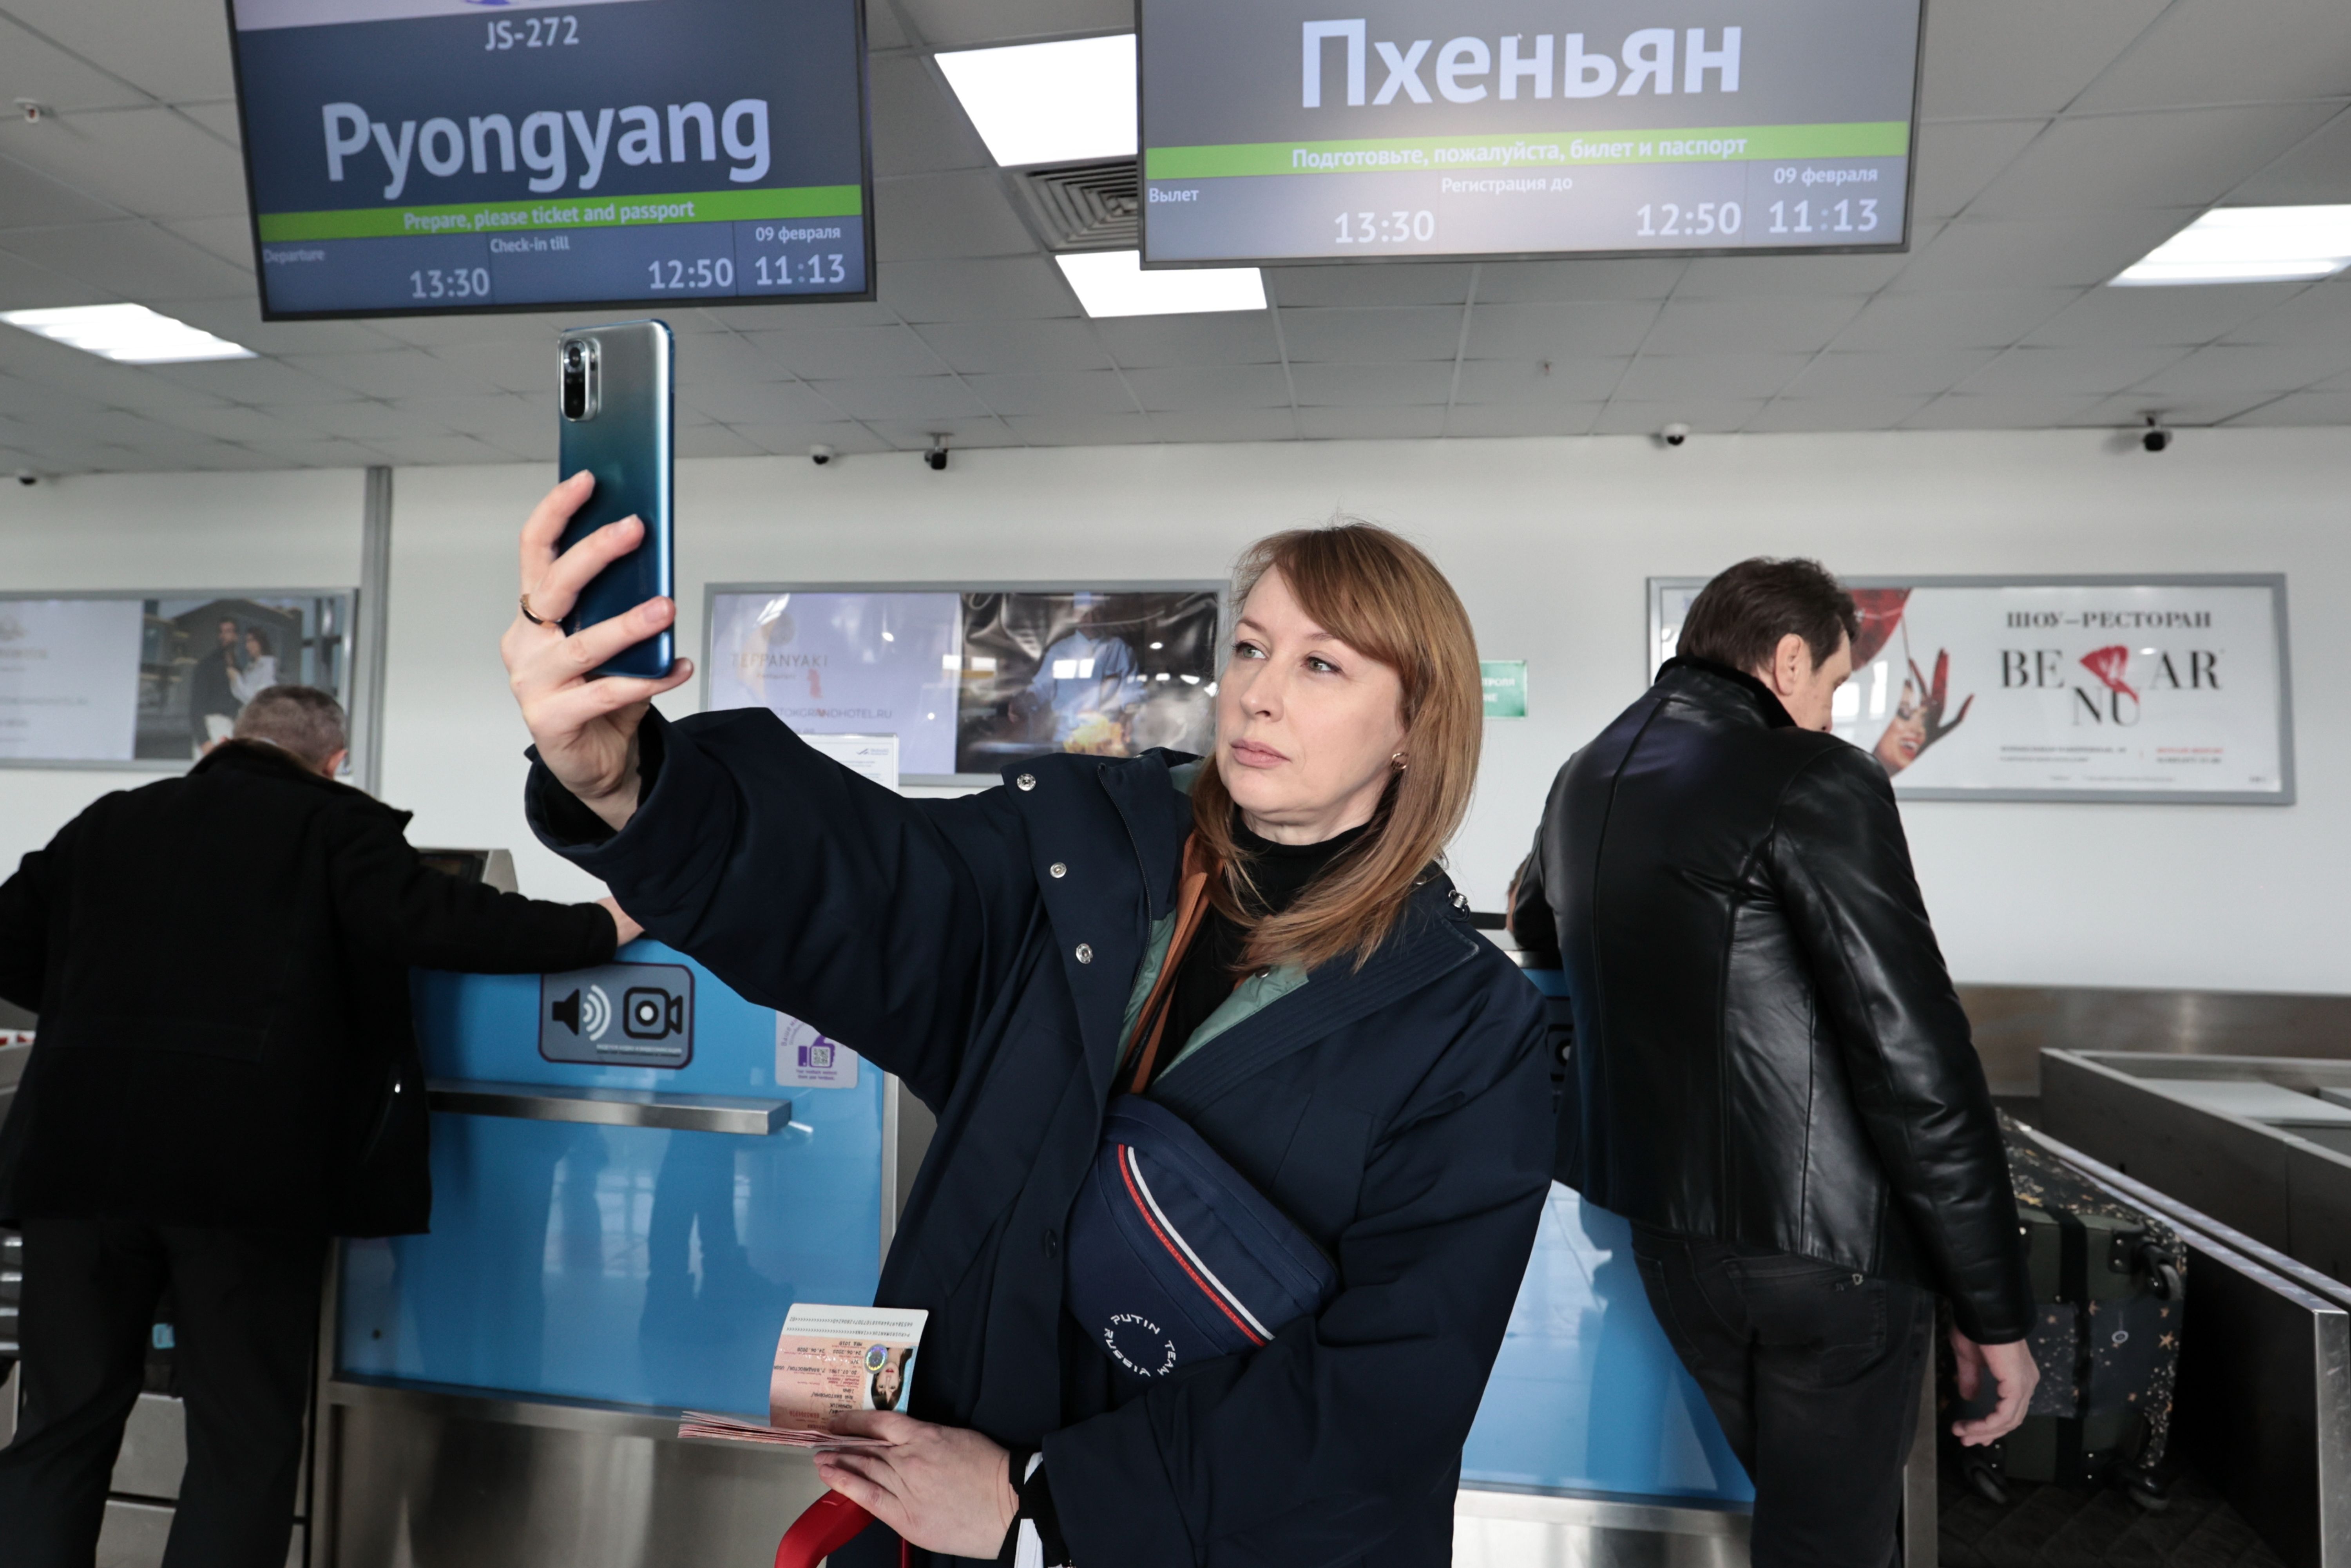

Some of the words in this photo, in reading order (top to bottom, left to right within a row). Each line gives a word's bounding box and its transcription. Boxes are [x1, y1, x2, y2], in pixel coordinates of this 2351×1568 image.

[485, 17, 579, 51] JS-272
[1302, 17, 1742, 109] Пхеньян
[321, 98, 771, 199] Pyongyang
[1292, 147, 1429, 170] Подготовьте,
[1434, 141, 1565, 166] пожалуйста,
[1570, 139, 1634, 159] билет
[1639, 142, 1652, 156] и
[1659, 139, 1748, 159] паспорт
[1441, 177, 1547, 195] Регистрация
[1550, 177, 1573, 192] до
[1774, 167, 1797, 184] 09
[1802, 167, 1878, 186] февраля
[1149, 187, 1199, 203] Вылет
[404, 213, 471, 233] Prepare,
[474, 210, 527, 230] please
[531, 206, 579, 225] ticket
[583, 203, 616, 222] and
[620, 201, 695, 224] passport
[1335, 210, 1435, 244] 13:30
[1636, 201, 1742, 235] 12:50
[1768, 198, 1878, 234] 11:13
[490, 237, 547, 253] Check-in
[550, 235, 570, 251] till
[755, 226, 774, 241] 09
[778, 226, 841, 243] февраля
[263, 248, 325, 265] Departure
[754, 253, 846, 286] 11:13
[409, 267, 490, 299] 13:30
[648, 257, 734, 289] 12:50
[732, 654, 828, 667] TEPPANYAKI
[1110, 1313, 1161, 1334] PUTIN
[1104, 1328, 1151, 1377] RUSSIA
[1157, 1340, 1176, 1376] TEAM
